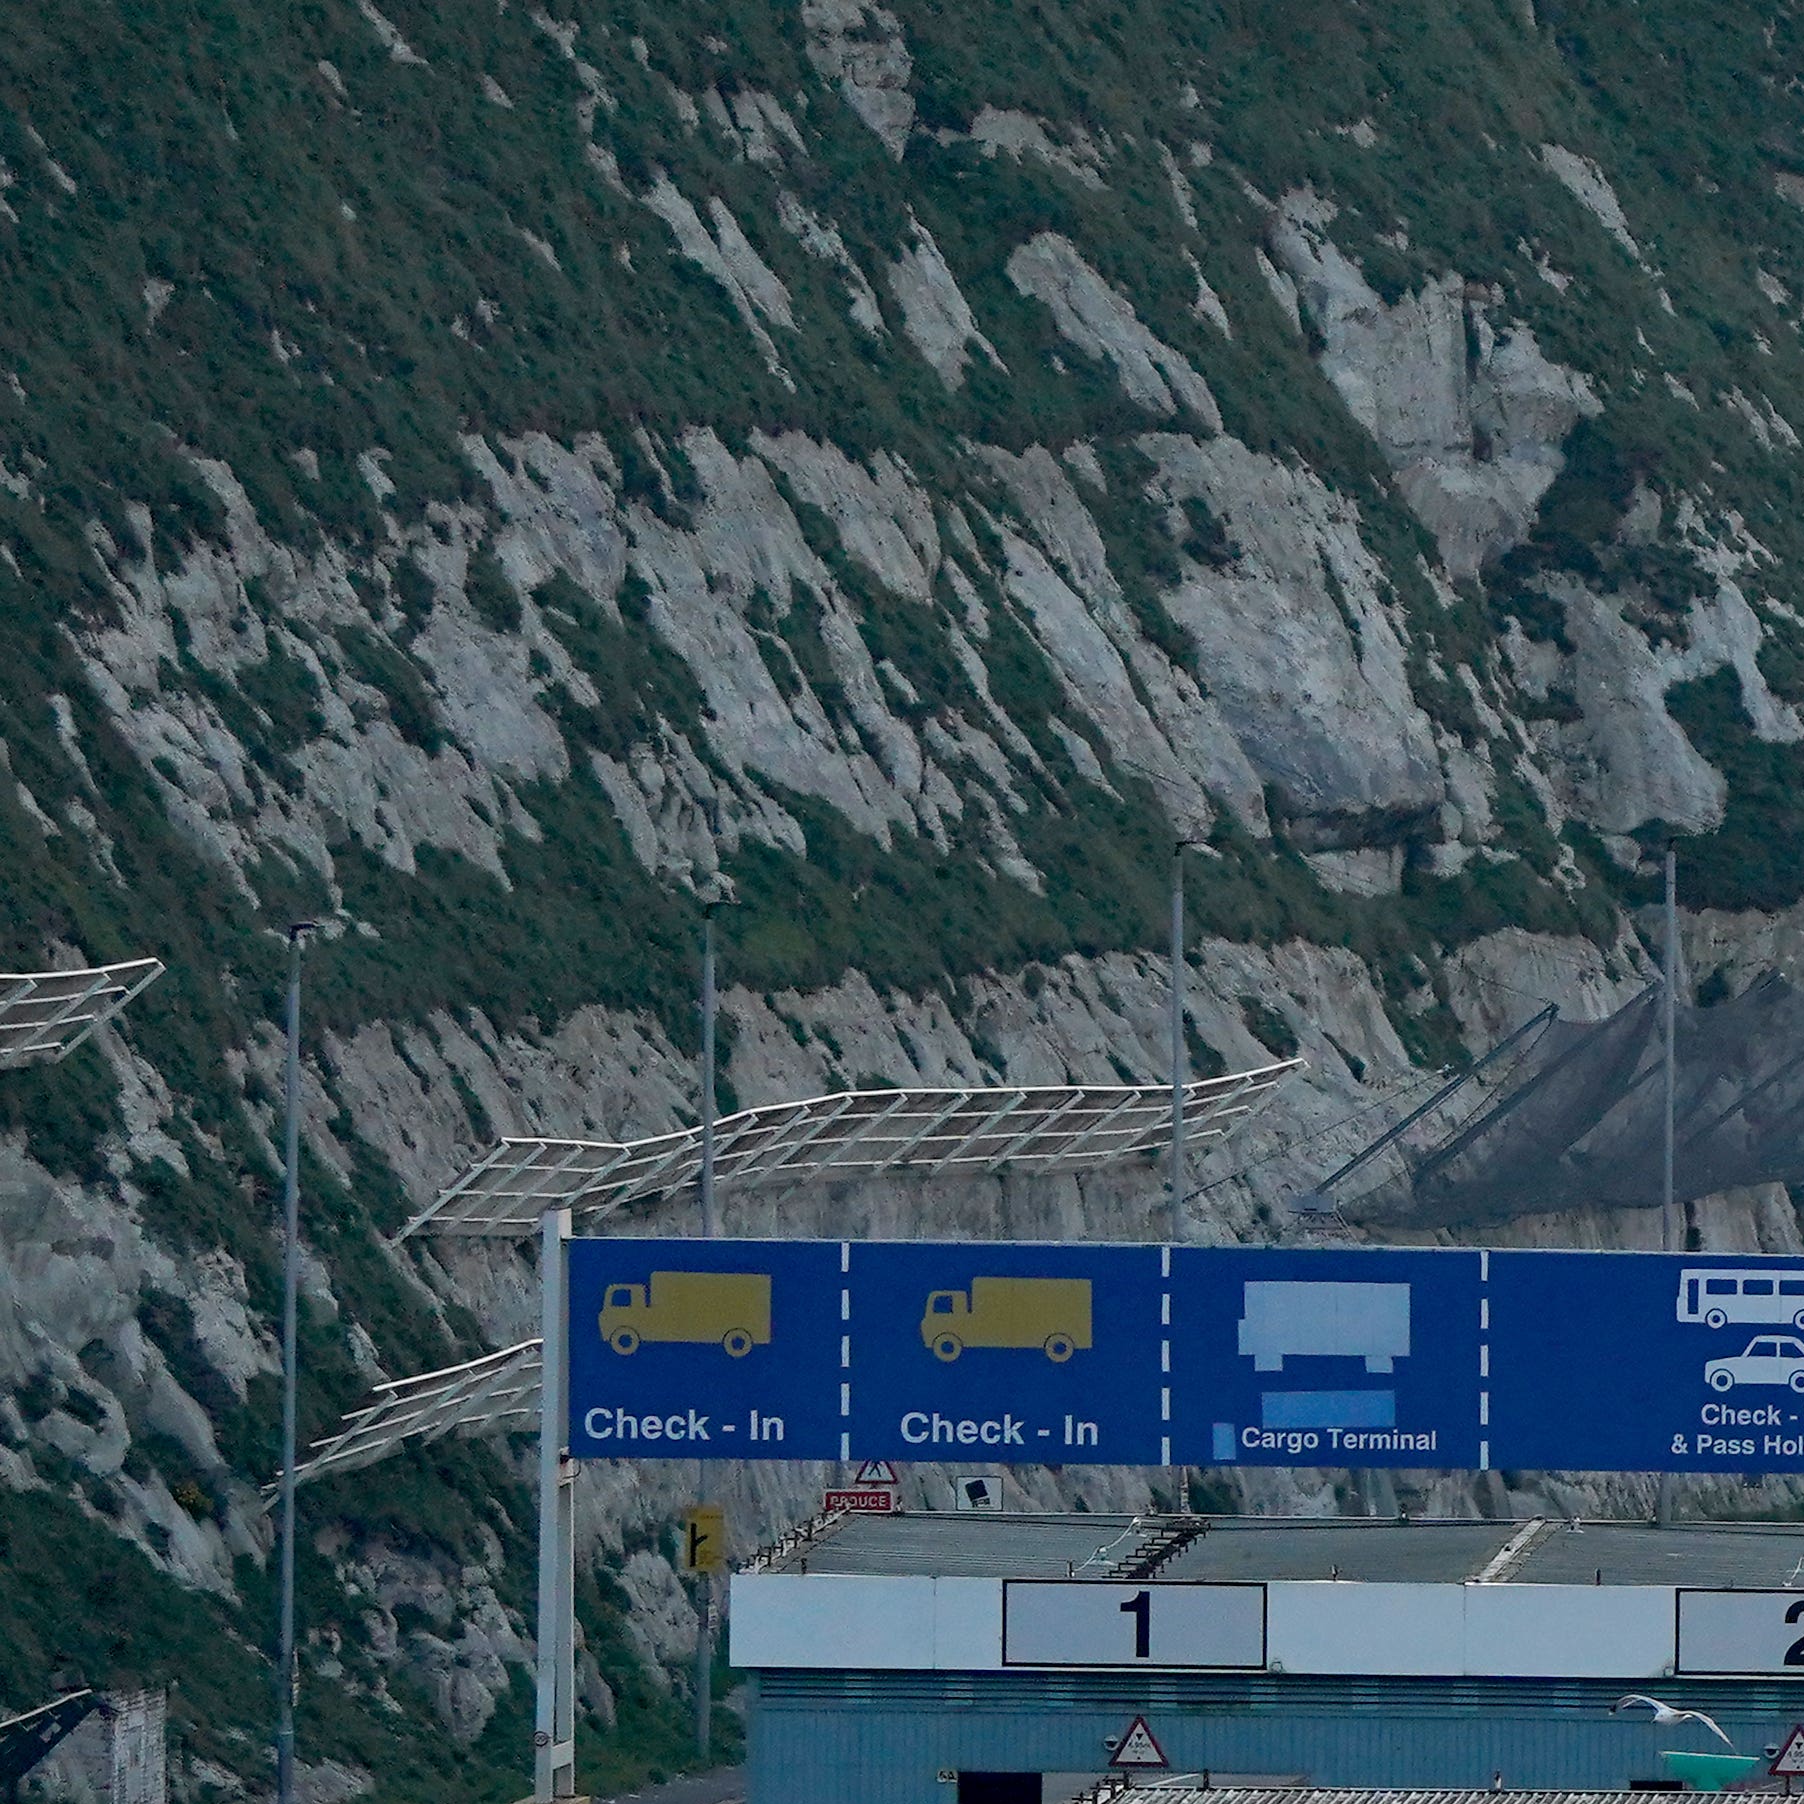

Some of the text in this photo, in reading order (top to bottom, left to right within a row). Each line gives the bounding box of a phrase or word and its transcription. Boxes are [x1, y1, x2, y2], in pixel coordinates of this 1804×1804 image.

[585, 1408, 710, 1441] Check
[750, 1410, 785, 1441] In
[900, 1411, 1025, 1446] Check
[1063, 1415, 1099, 1446] In
[1701, 1403, 1781, 1425] Check
[1242, 1426, 1437, 1454] Cargo Terminal
[1670, 1433, 1688, 1454] &
[1697, 1435, 1756, 1455] Pass
[1119, 1591, 1150, 1658] 1
